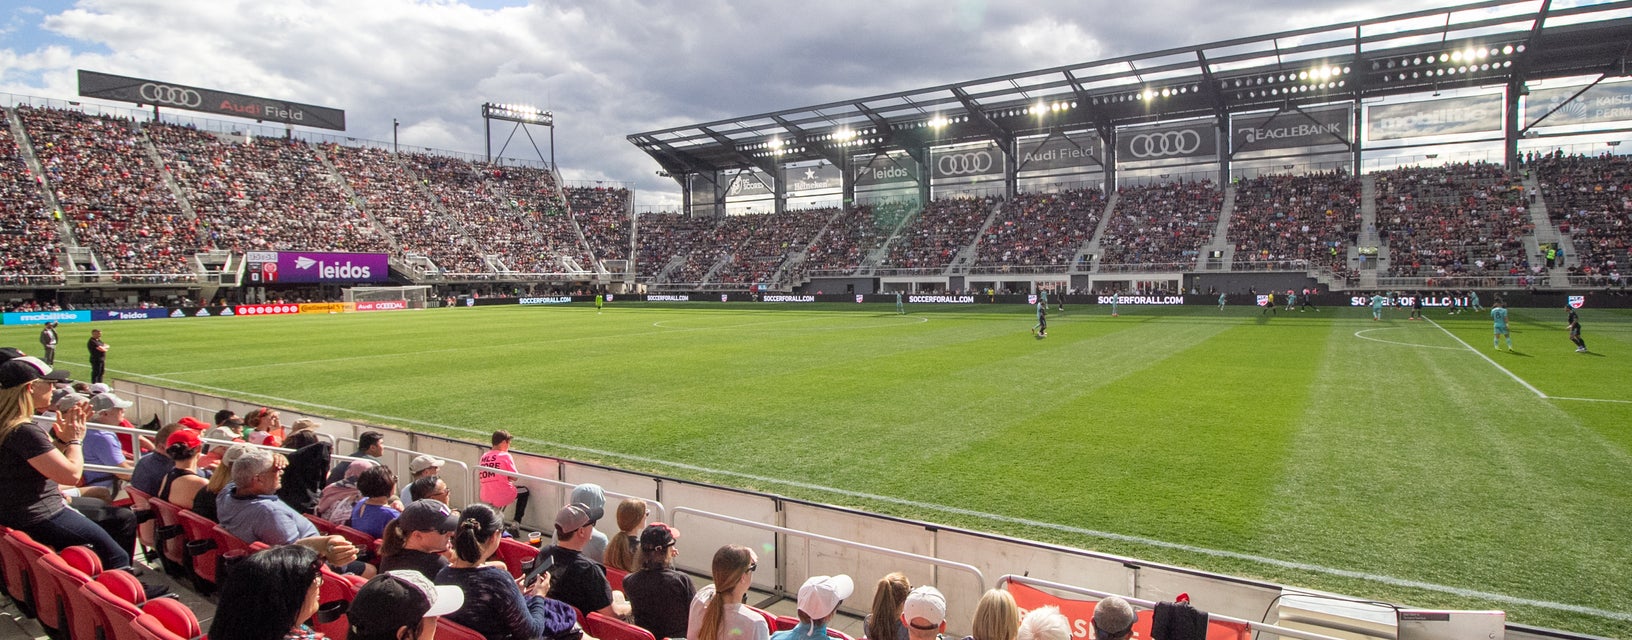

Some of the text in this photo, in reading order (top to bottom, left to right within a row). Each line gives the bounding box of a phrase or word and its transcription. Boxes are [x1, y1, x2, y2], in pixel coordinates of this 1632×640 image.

[1596, 94, 1632, 106] KAISE
[219, 100, 303, 120] Audi Field
[1024, 146, 1094, 161] Audi Field
[873, 166, 907, 179] leidos
[794, 181, 828, 190] Heineken
[319, 261, 371, 279] leidos
[251, 272, 259, 281] 0
[268, 272, 273, 281] 1
[519, 296, 572, 304] SOCCERFORALL.COM
[1098, 296, 1184, 304] SOCERFORALL.COM
[20, 313, 77, 321] mobilitie
[120, 311, 148, 319] leidos
